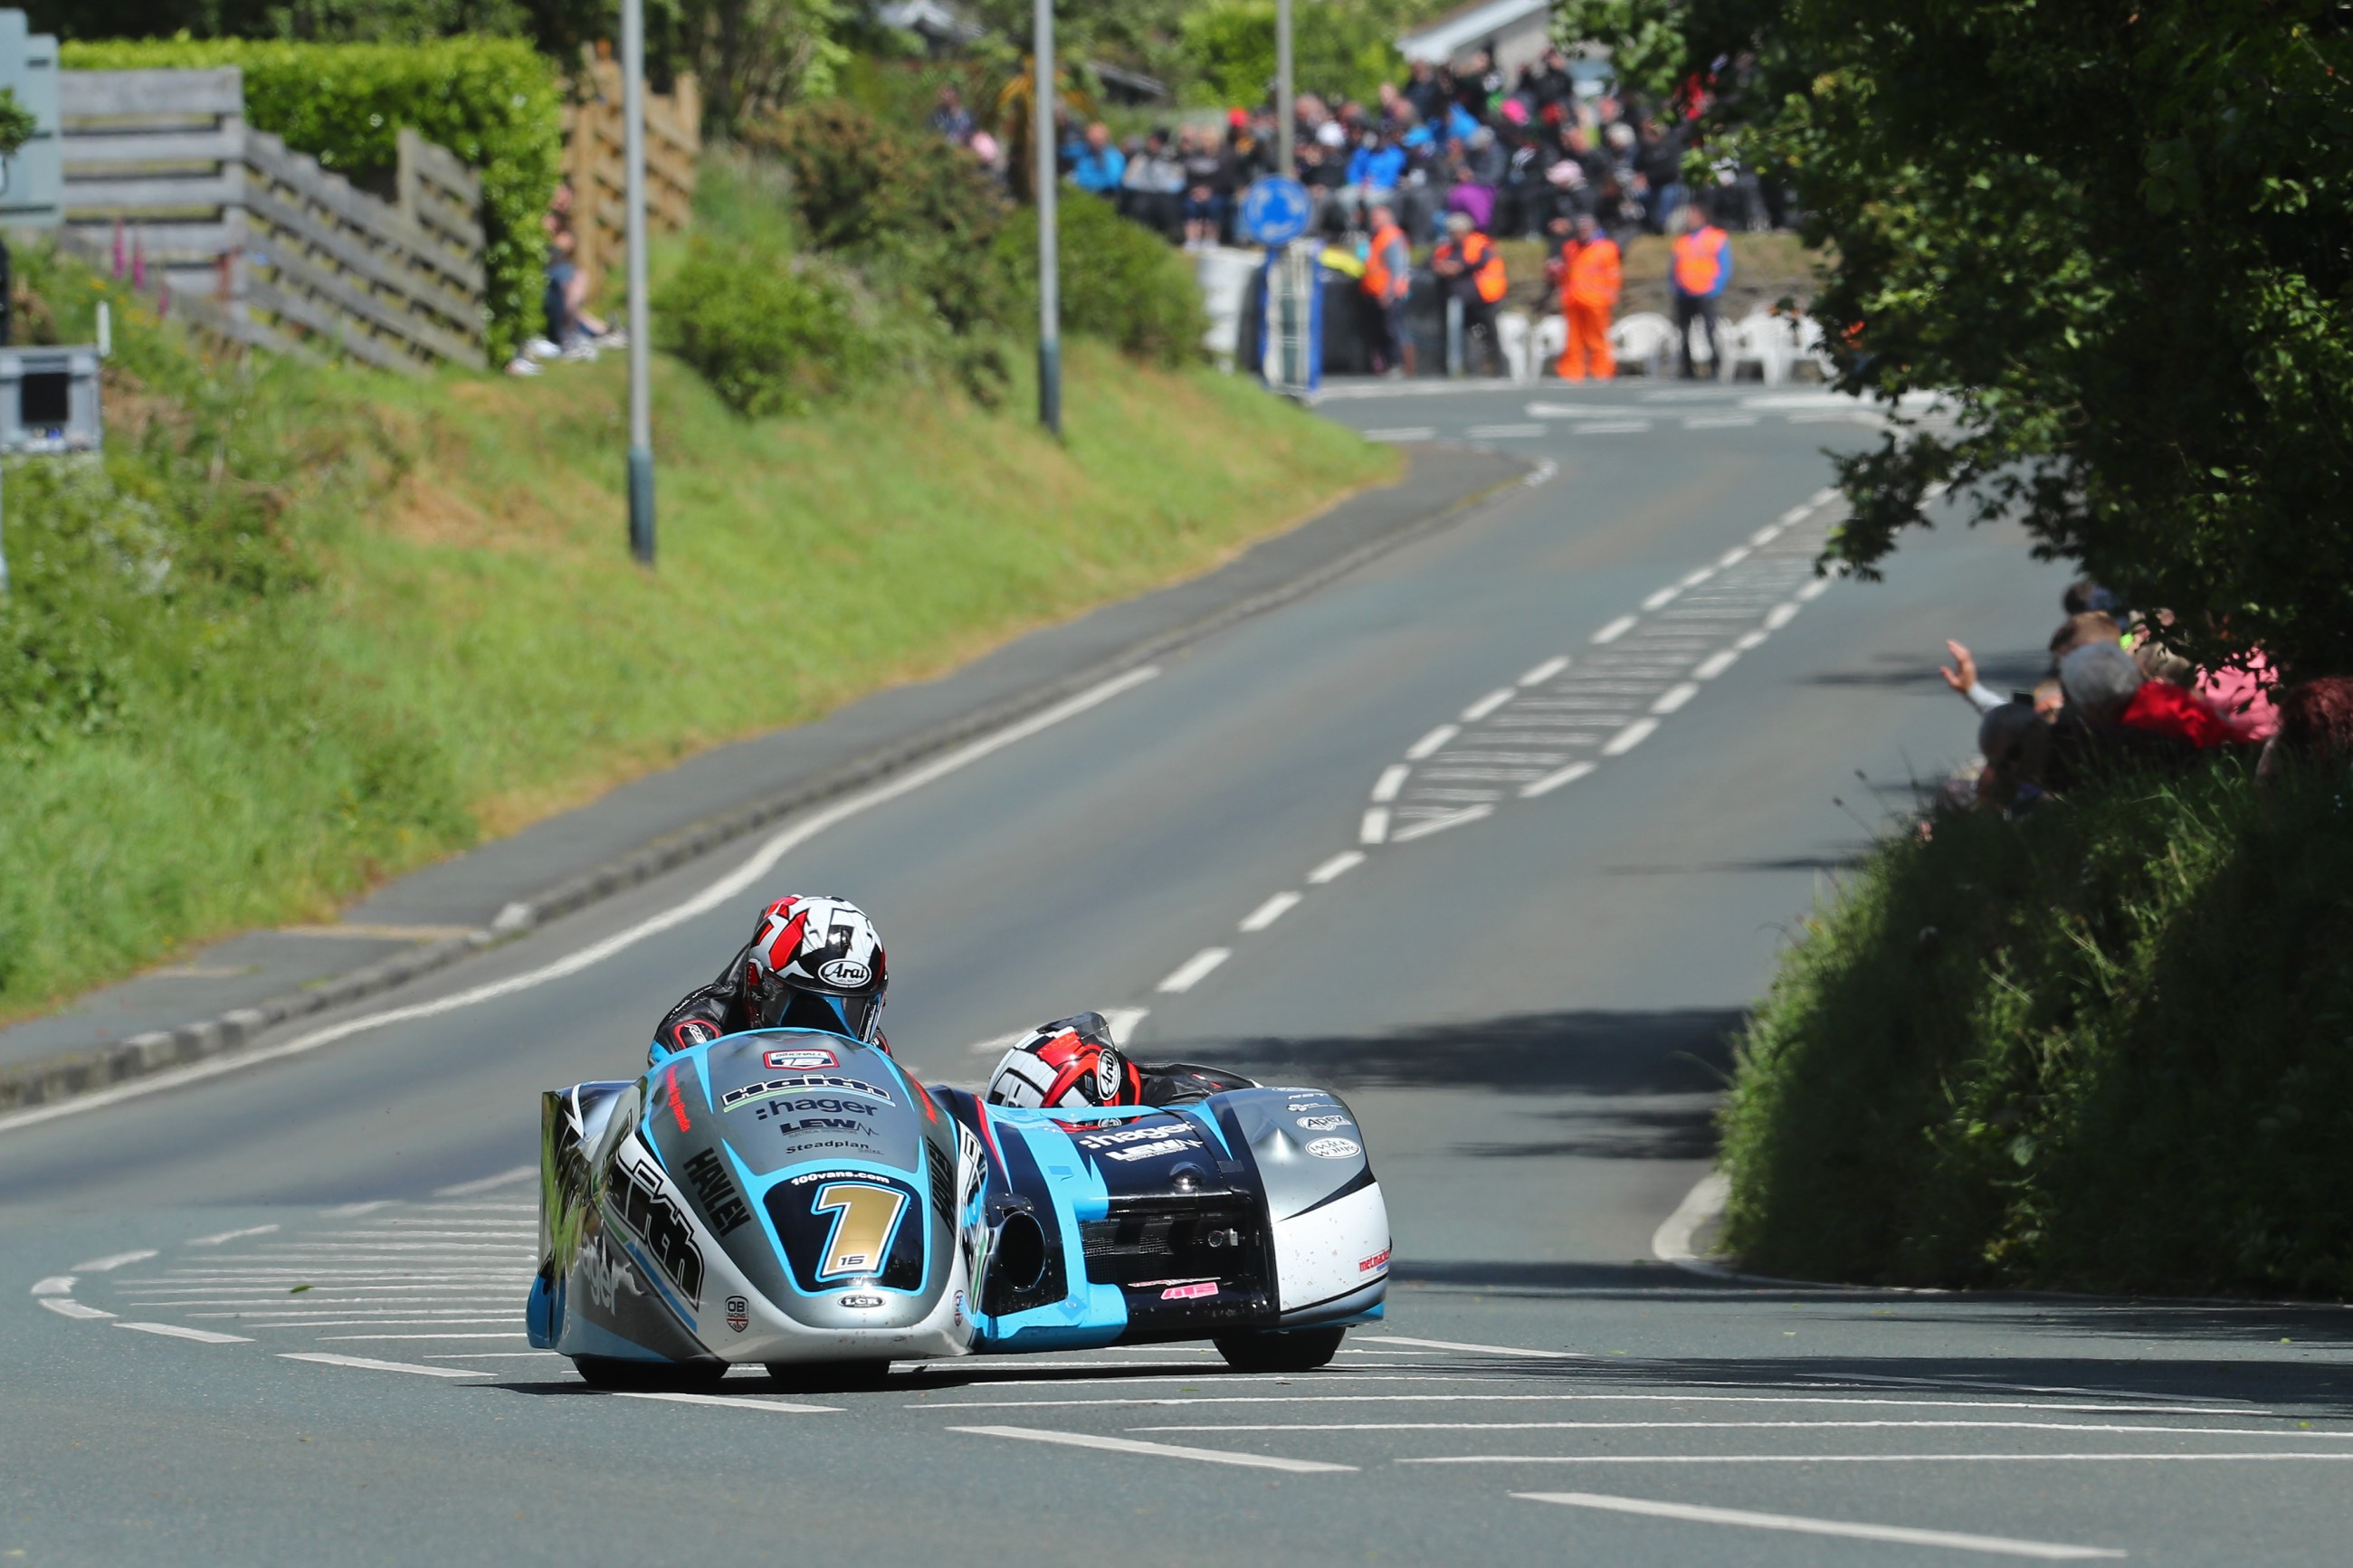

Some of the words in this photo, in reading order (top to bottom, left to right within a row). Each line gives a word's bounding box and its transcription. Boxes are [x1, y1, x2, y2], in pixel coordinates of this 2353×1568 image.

[823, 963, 866, 981] Arai
[722, 1074, 891, 1106] Haith
[779, 1118, 857, 1135] LEW
[786, 1140, 869, 1155] Steadplan
[790, 1170, 891, 1186] 100vans.com
[682, 1146, 752, 1238] HAYLEY
[816, 1183, 906, 1277] 1
[727, 1301, 746, 1313] OB
